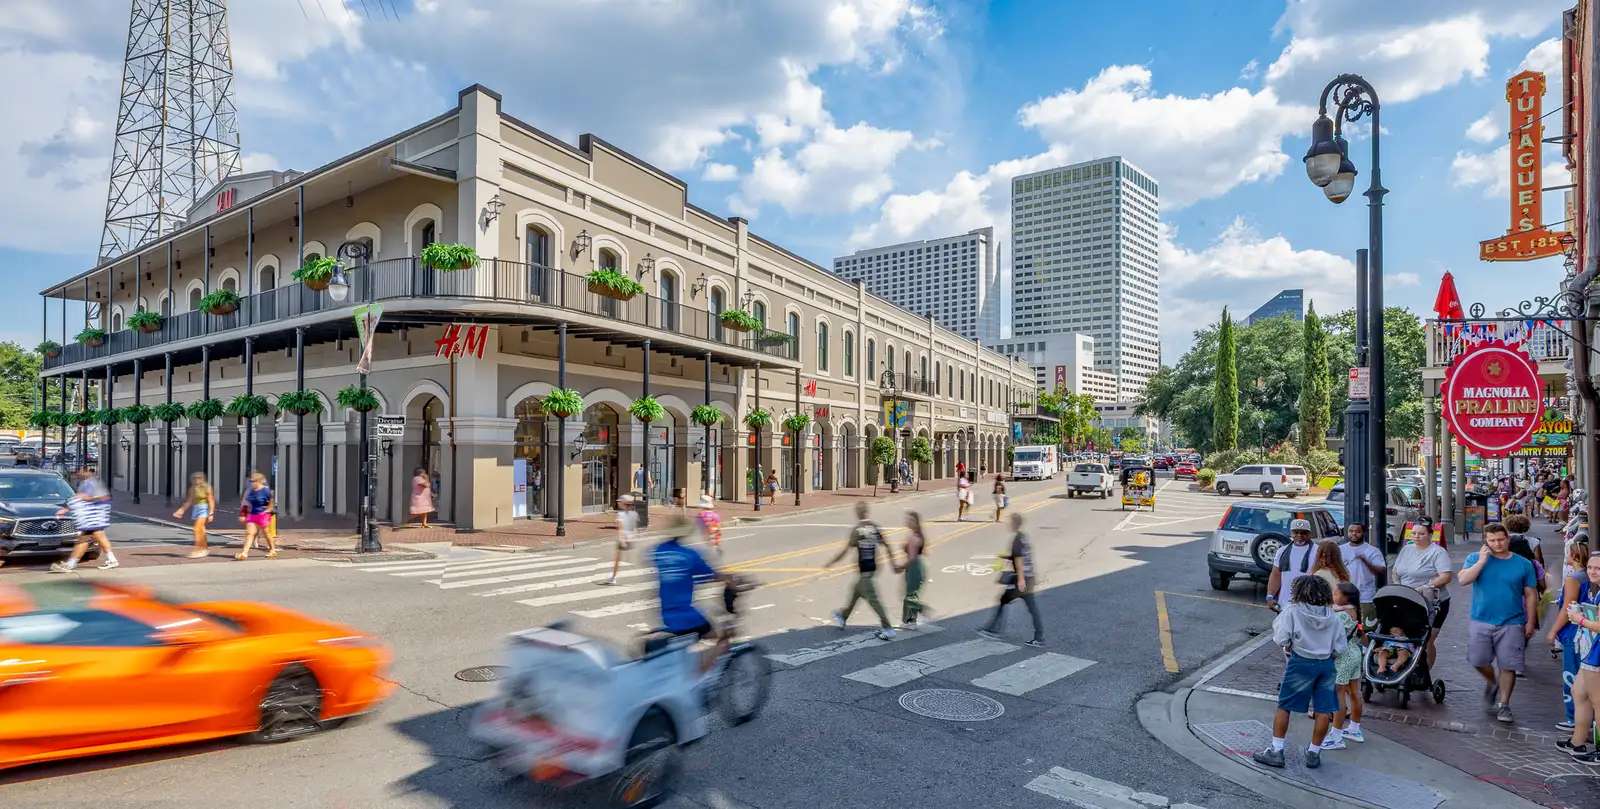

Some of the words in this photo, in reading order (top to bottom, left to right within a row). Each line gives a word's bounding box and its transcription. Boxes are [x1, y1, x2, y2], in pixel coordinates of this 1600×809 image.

[1517, 77, 1535, 232] TUJAGUE'S
[1485, 240, 1520, 254] EST
[1530, 236, 1560, 249] 185
[434, 324, 490, 359] H&M
[1463, 386, 1530, 399] MAGNOLIA
[1455, 400, 1537, 414] PRALINE
[1470, 417, 1526, 428] COMPANY
[1532, 420, 1572, 434] AYOU
[1544, 447, 1568, 456] STORE
[513, 484, 526, 493] LE
